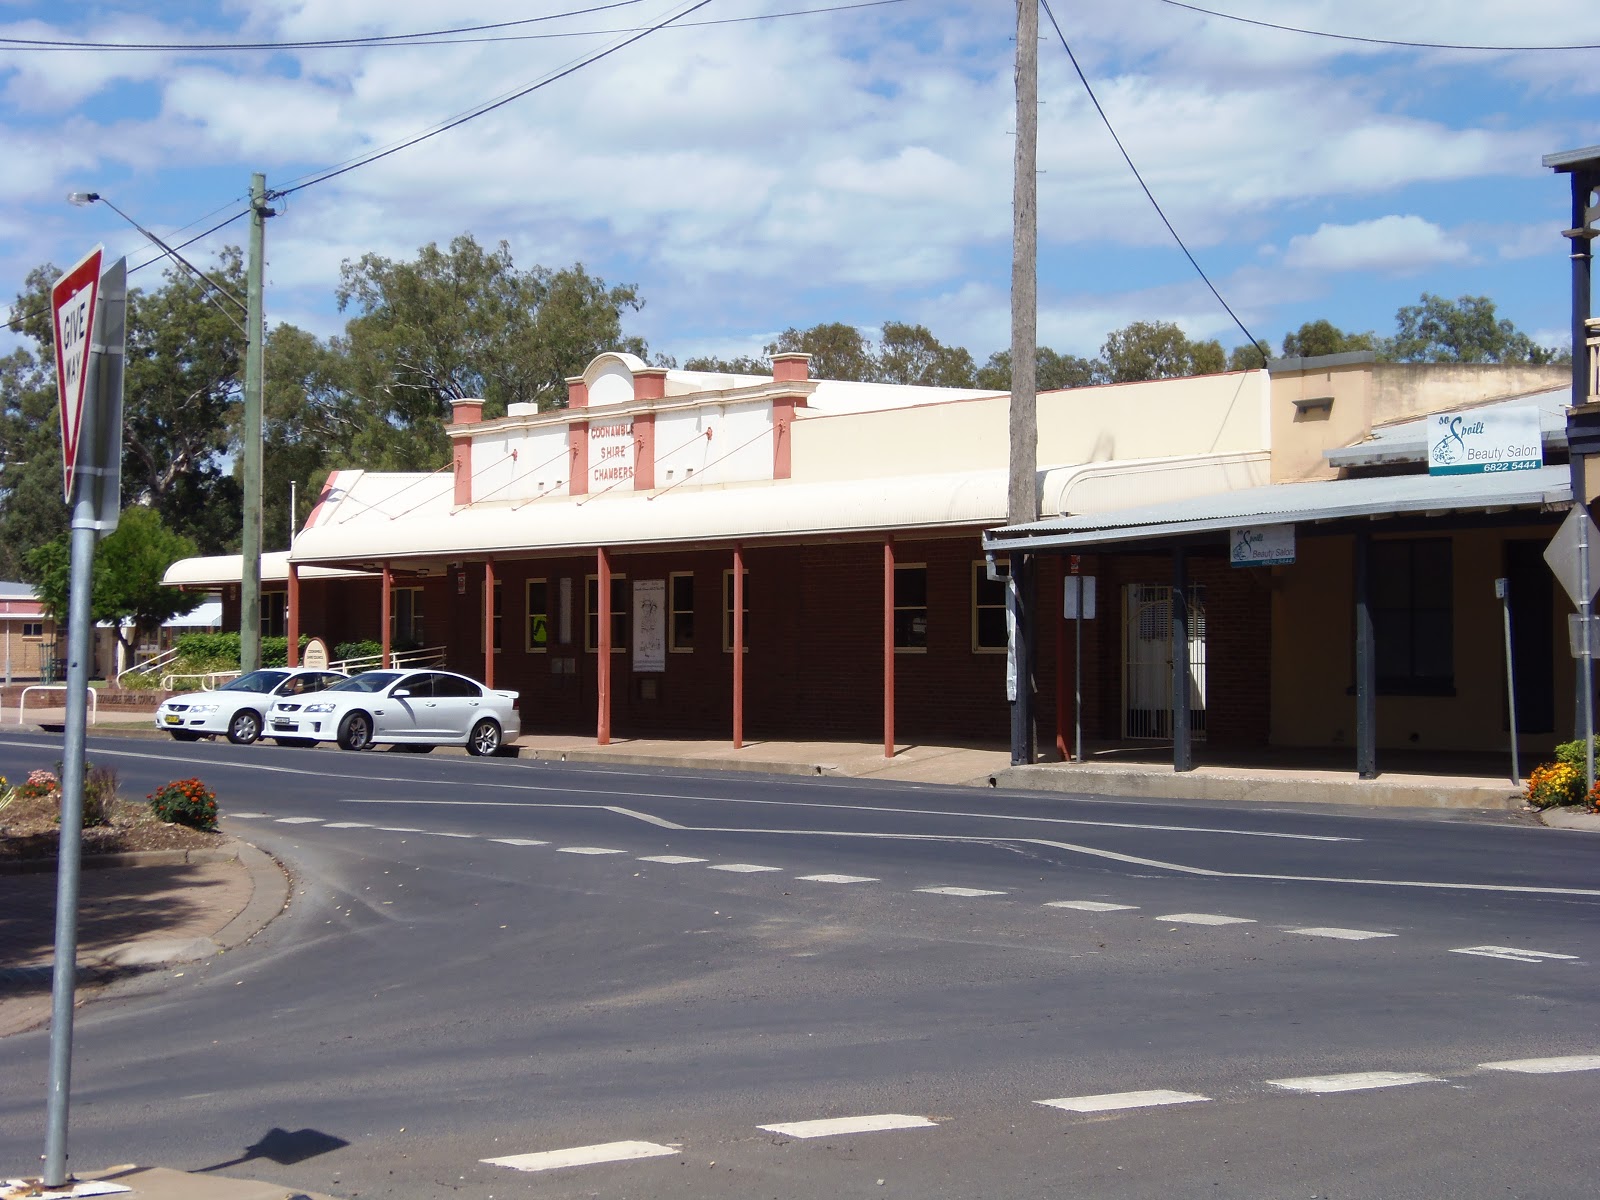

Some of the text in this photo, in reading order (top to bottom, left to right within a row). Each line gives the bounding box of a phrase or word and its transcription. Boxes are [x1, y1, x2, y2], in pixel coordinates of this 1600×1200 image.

[64, 301, 86, 350] GIVE
[65, 350, 82, 388] WAY
[601, 445, 626, 459] SHIRE
[1467, 444, 1537, 461] Beauty Salon
[594, 466, 634, 481] CHAMBERS
[1483, 460, 1537, 472] 6822 5444
[1252, 547, 1294, 559] Beauty Salon
